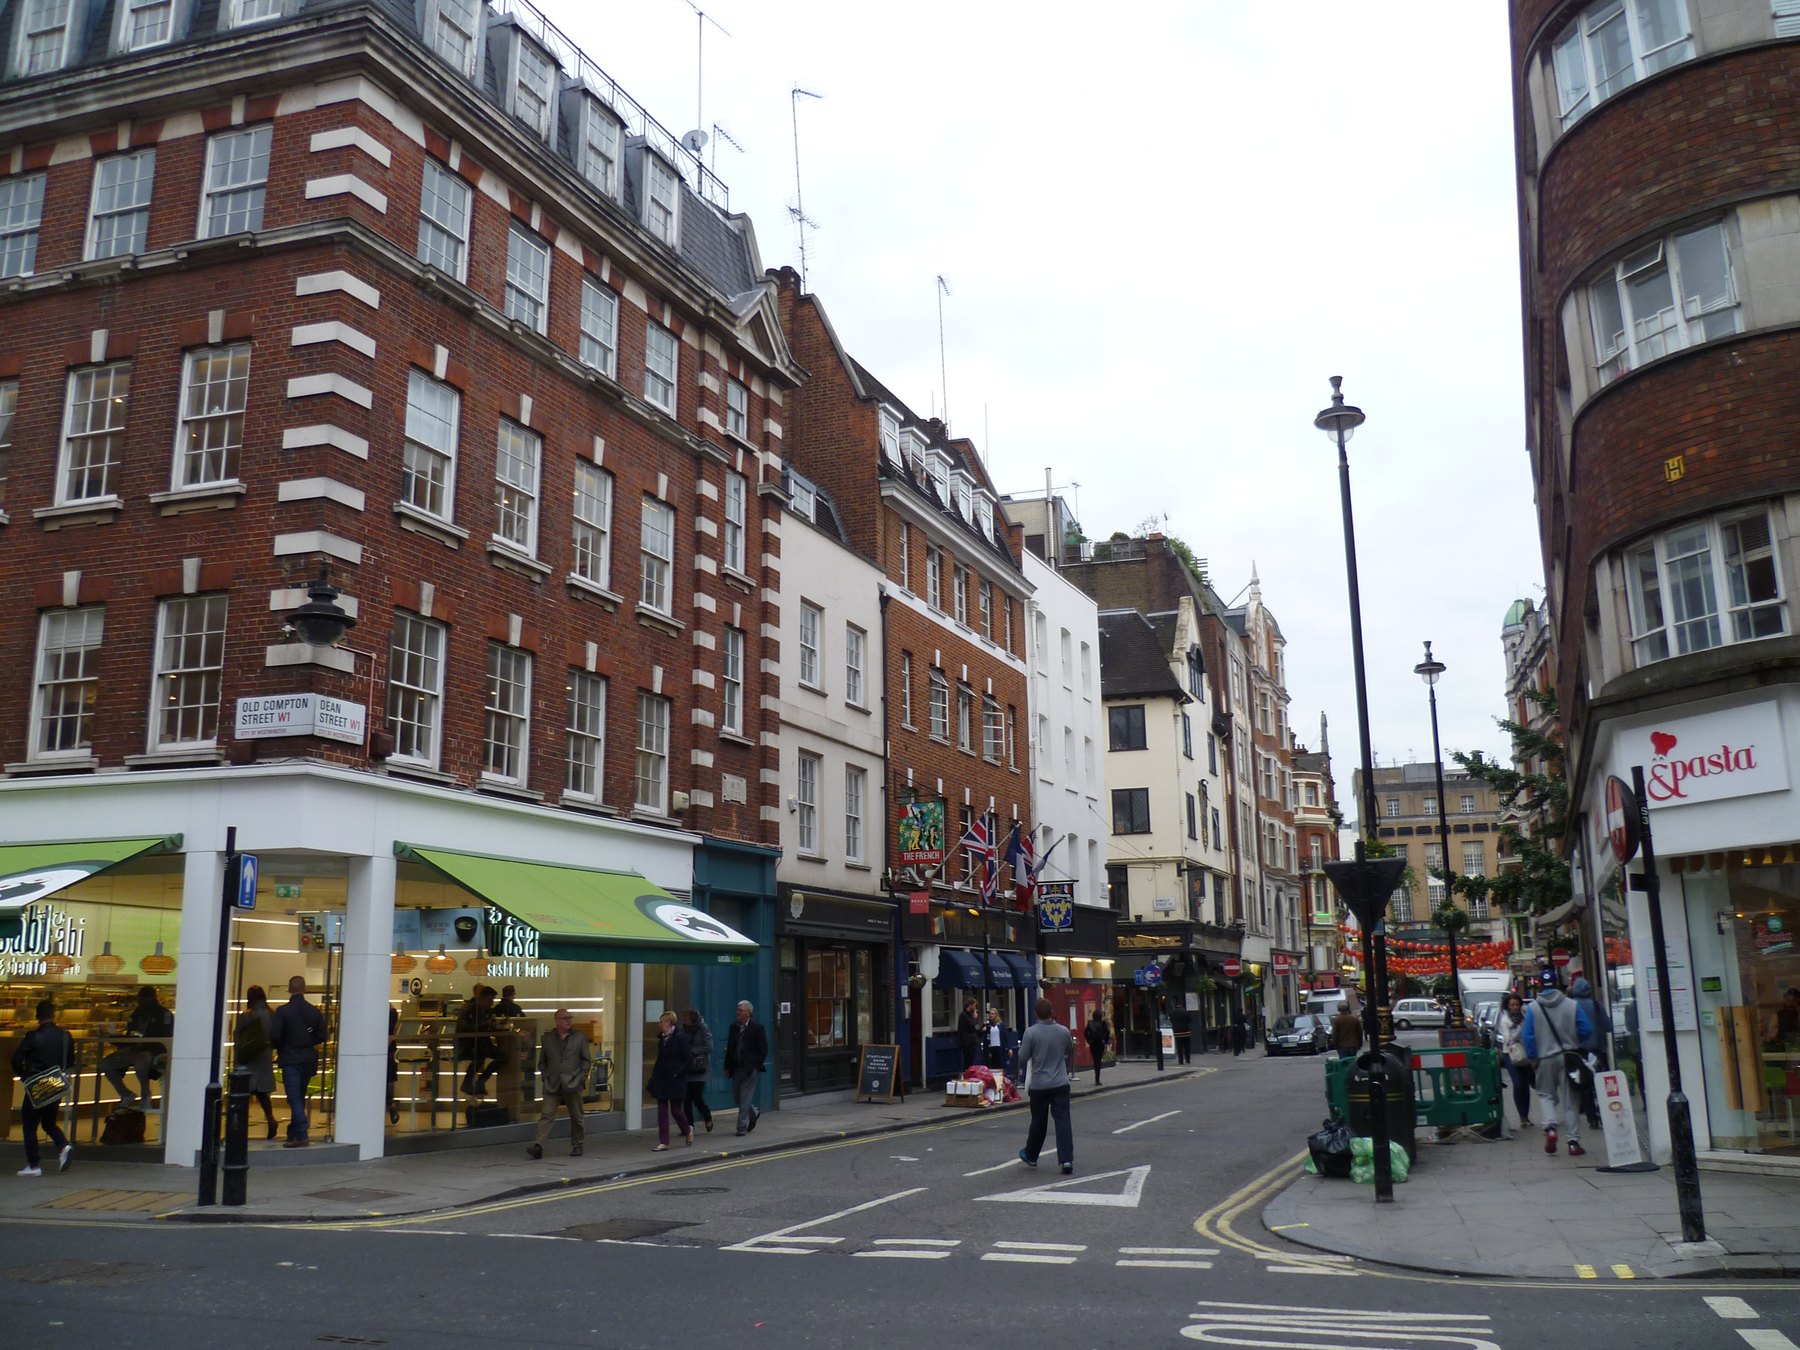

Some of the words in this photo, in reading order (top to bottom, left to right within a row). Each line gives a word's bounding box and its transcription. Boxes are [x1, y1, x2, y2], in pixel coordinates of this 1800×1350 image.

[242, 701, 260, 712] OLD
[263, 698, 308, 711] COMPTON
[320, 700, 341, 714] DEAN
[241, 712, 275, 725] STREET
[278, 712, 290, 723] W1
[319, 712, 348, 728] STREET
[350, 719, 360, 731] W1
[903, 852, 914, 861] THE
[915, 851, 940, 860] FRENCH
[487, 960, 512, 977] sushi
[525, 961, 550, 978] bento
